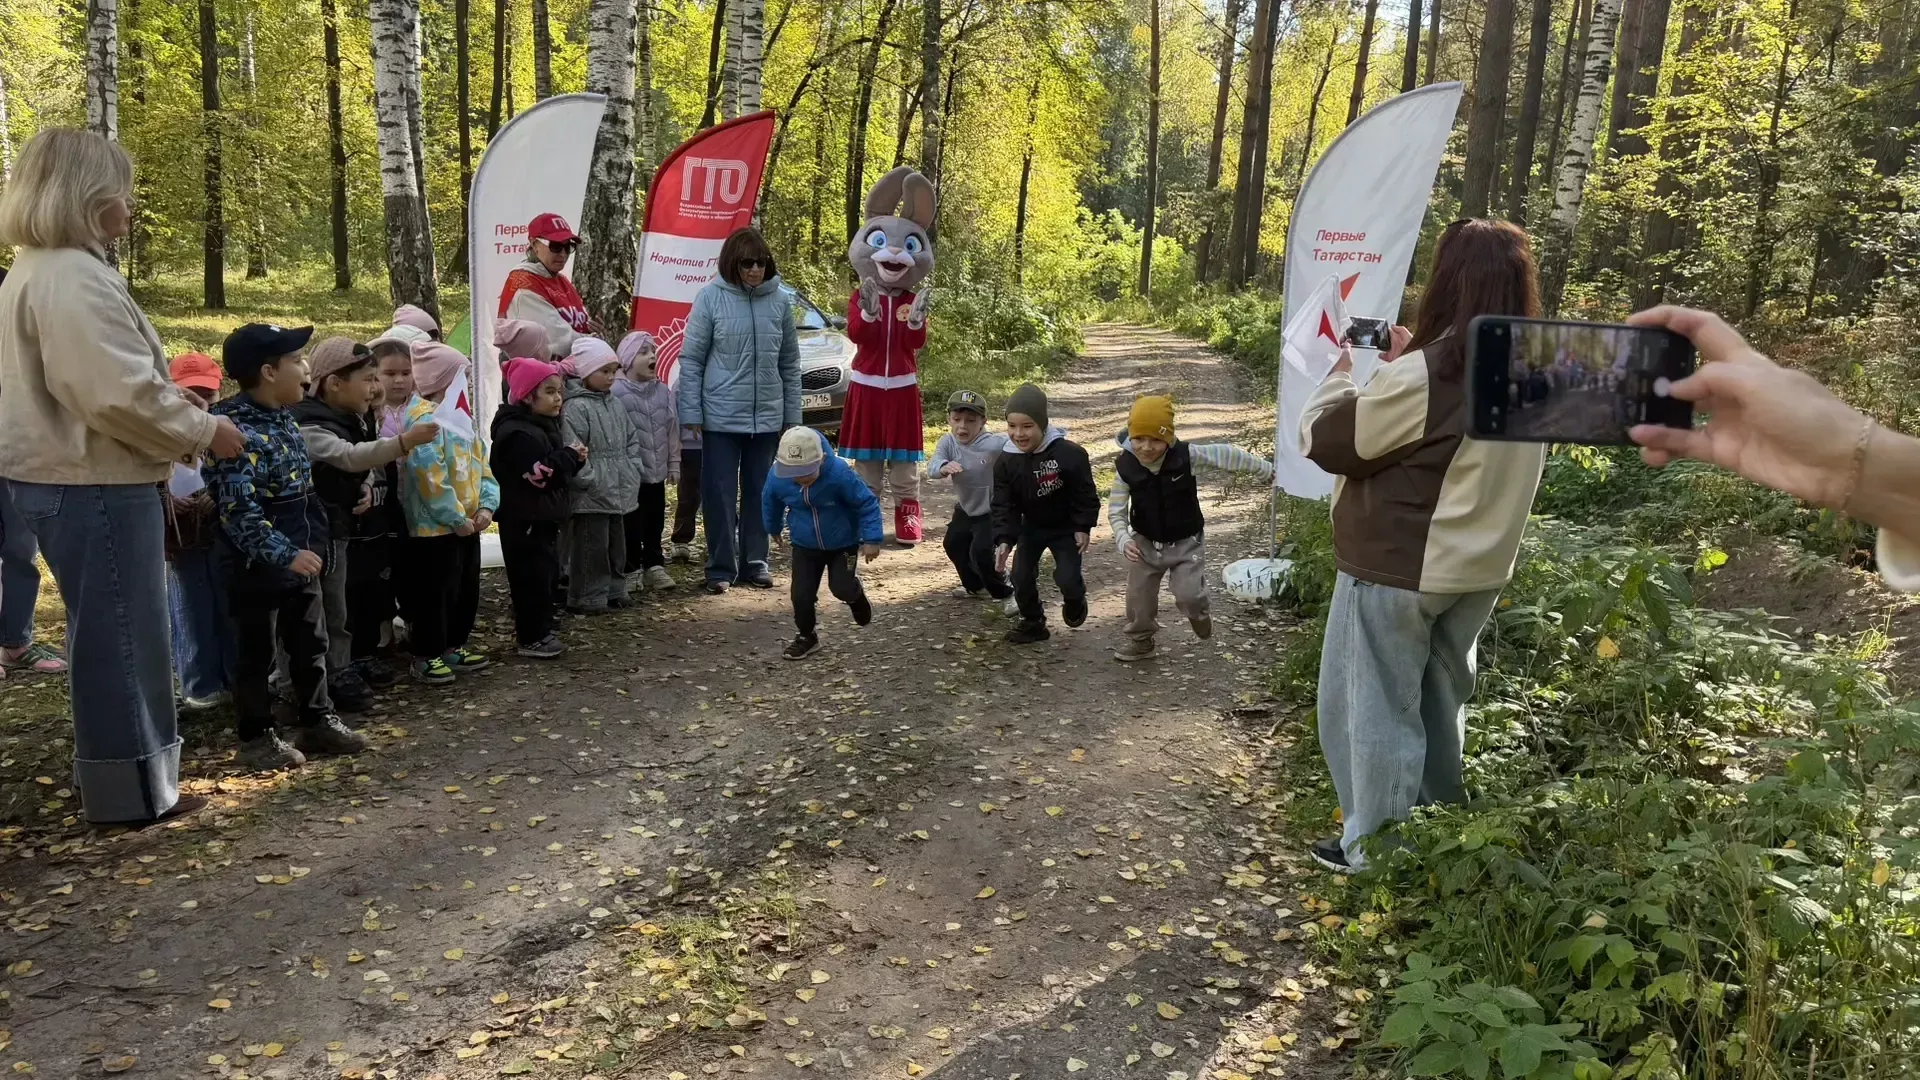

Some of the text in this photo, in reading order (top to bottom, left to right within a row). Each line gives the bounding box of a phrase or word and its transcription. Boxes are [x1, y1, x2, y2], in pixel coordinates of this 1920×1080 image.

[680, 155, 749, 205] ГТО
[495, 224, 528, 238] Перв
[1316, 229, 1366, 245] Первые
[494, 242, 529, 254] Тата
[1312, 248, 1382, 264] Татарстан
[650, 251, 704, 268] Норматив
[675, 272, 707, 284] норма
